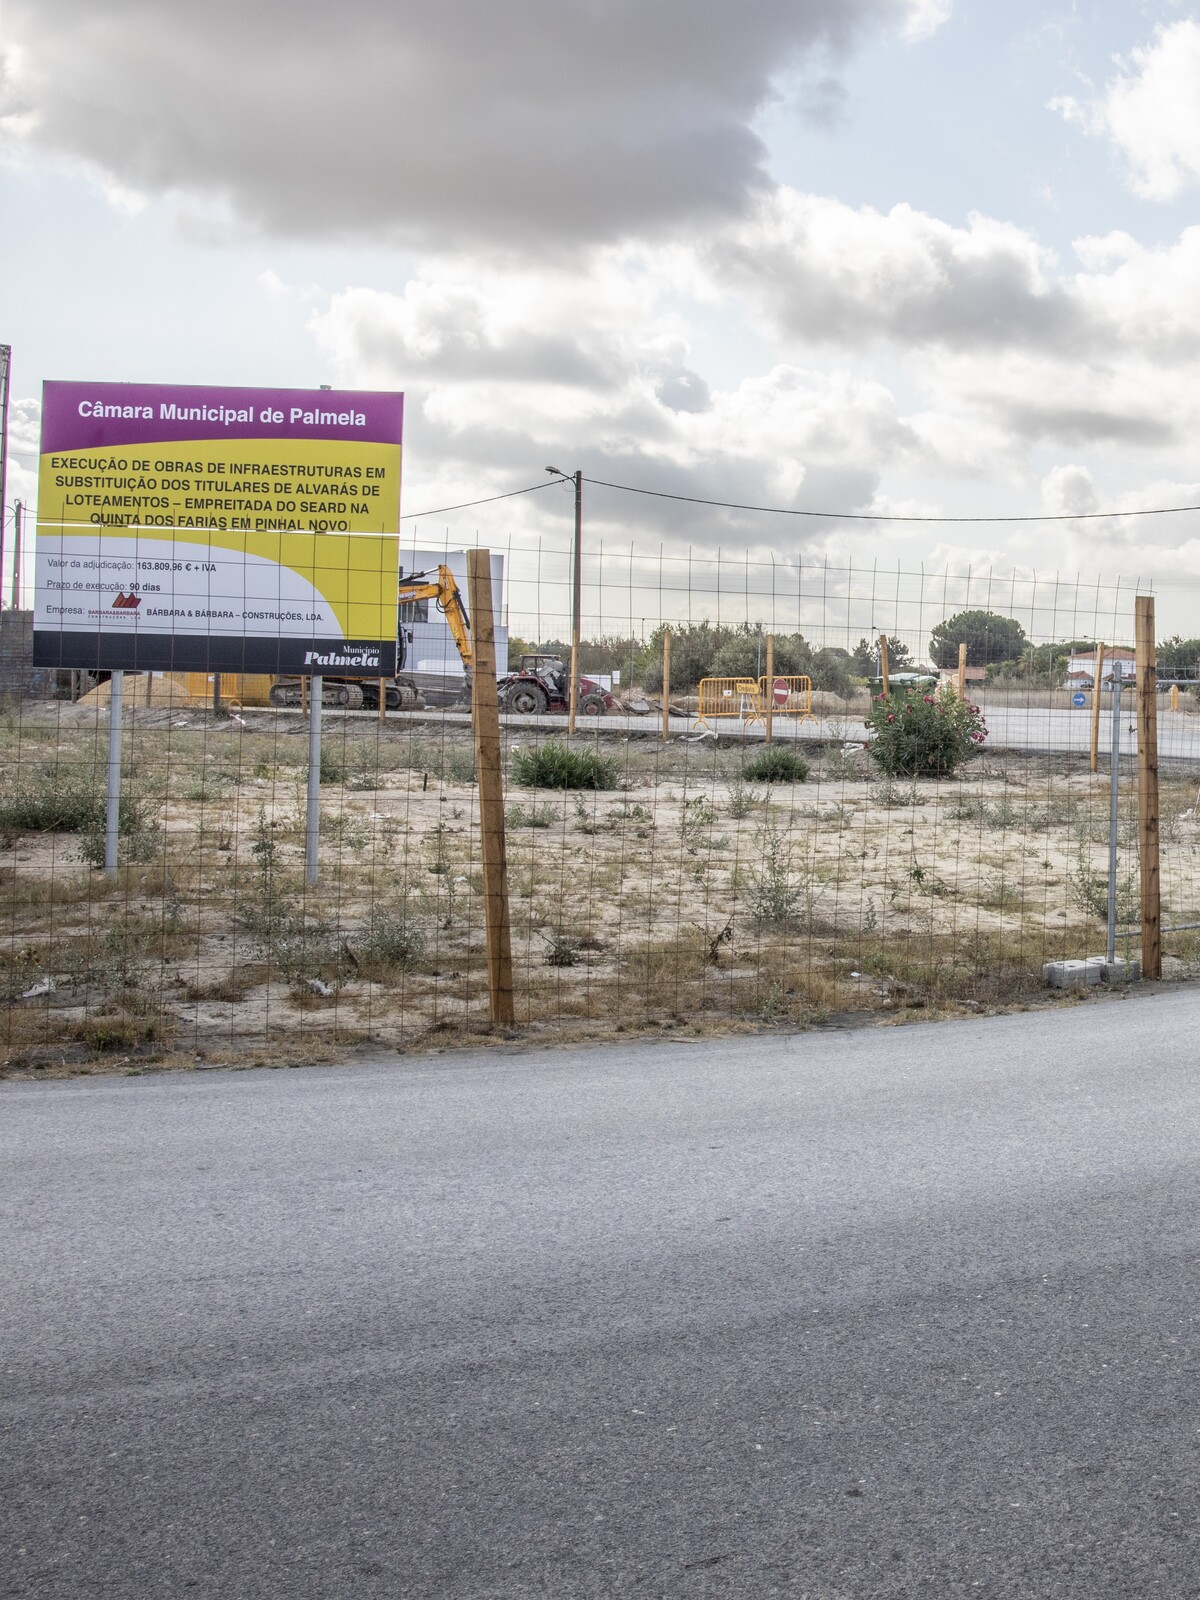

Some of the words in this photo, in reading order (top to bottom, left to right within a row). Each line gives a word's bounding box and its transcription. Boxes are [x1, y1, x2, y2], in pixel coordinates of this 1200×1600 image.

[78, 401, 153, 419] Câmara
[160, 403, 254, 425] Municipal
[259, 407, 284, 424] de
[290, 408, 366, 426] Palmela
[51, 457, 128, 472] EXECUÇÃO
[132, 460, 150, 471] DE
[154, 461, 203, 473] OBRAS
[208, 462, 226, 474] DE
[230, 464, 362, 478] INFRAESTRUTURAS
[366, 468, 385, 478] EM
[56, 476, 157, 492] SUBSTITUIÇÃO
[162, 479, 190, 490] DOS
[194, 480, 270, 493] TITULARES
[274, 482, 292, 494] DE
[296, 482, 358, 496] ALVARÁS
[362, 486, 380, 496] DE
[66, 494, 170, 508] LOTEAMENTOS
[185, 498, 272, 512] EMPREITADA
[276, 500, 296, 512] DO
[300, 502, 346, 514] SEARD
[350, 503, 369, 514] NA
[90, 513, 140, 525] QUINTA
[144, 515, 174, 526] DOS
[178, 516, 227, 528] FARIAS
[232, 518, 250, 529] EM
[256, 518, 304, 530] PINHAL
[308, 520, 348, 532] NOVO
[48, 559, 68, 568] Valor
[70, 560, 80, 568] da
[83, 560, 134, 571] adjudicação:
[137, 562, 182, 572] 163.809,96
[185, 563, 192, 572] €
[202, 564, 216, 572] IVA
[46, 580, 70, 589] Prazo
[75, 581, 84, 589] de
[86, 582, 128, 592] execução:
[130, 582, 140, 590] 90
[142, 583, 160, 591] dias
[46, 605, 85, 616] Empresa:
[146, 607, 186, 617] BÁRBARA
[195, 609, 234, 618] BÁRBARA
[242, 611, 304, 621] CONSTRUÇÕES,
[343, 646, 380, 654] Município
[304, 652, 380, 666] Palmela
